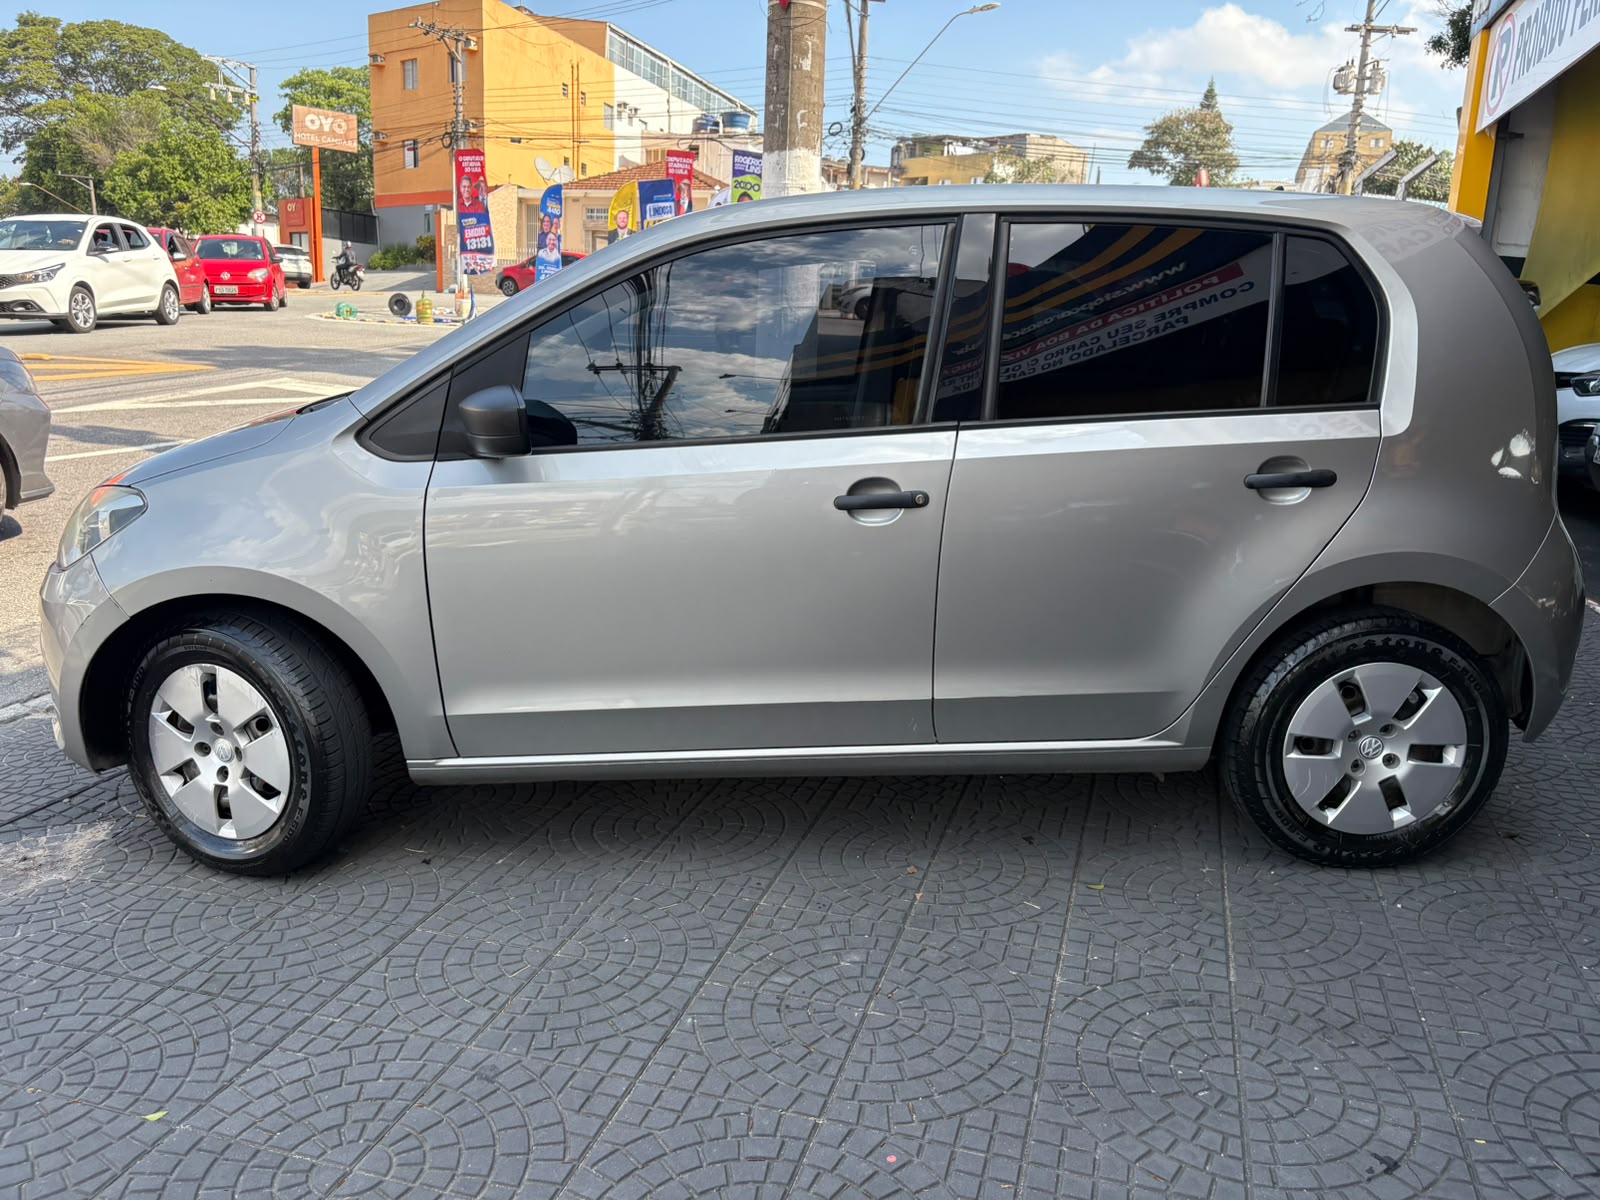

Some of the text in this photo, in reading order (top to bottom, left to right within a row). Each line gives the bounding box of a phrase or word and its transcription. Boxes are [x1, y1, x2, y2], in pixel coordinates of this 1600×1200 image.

[1511, 0, 1570, 85] PROIBIDO
[305, 113, 348, 135] OYO
[294, 132, 320, 143] HOTEL
[466, 235, 492, 250] 13131
